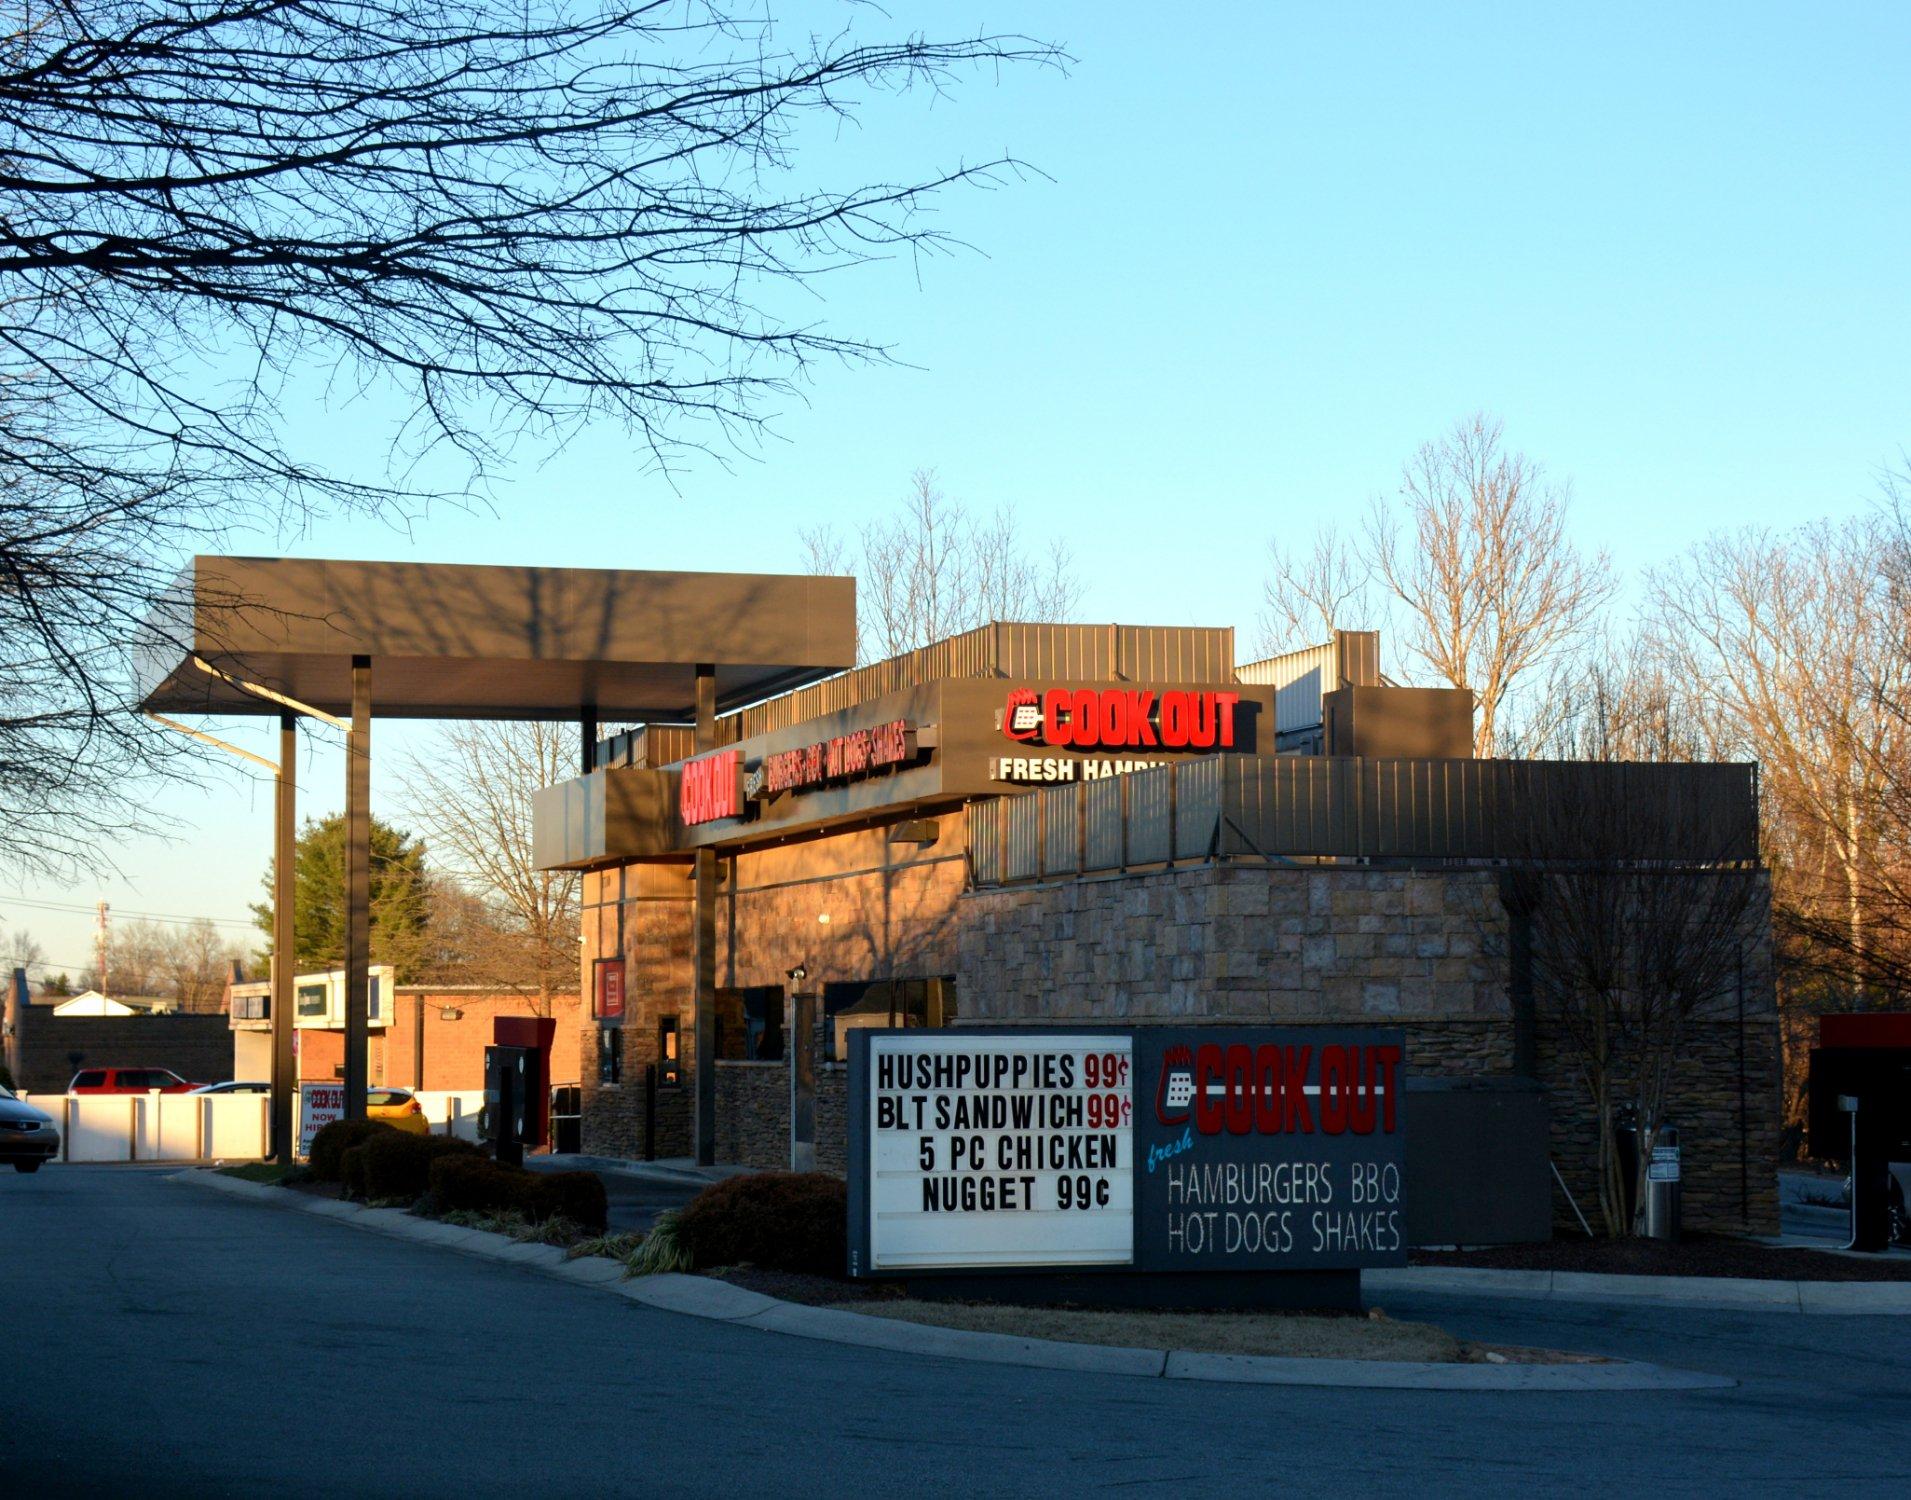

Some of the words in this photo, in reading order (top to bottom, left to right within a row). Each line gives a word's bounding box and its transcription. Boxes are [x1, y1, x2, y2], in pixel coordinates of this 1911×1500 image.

[1042, 688, 1157, 746] COOK
[1159, 690, 1239, 747] OUT
[871, 718, 905, 767] SHAKES
[681, 757, 714, 826] COOK
[713, 750, 738, 819] OUT
[1000, 758, 1074, 781] FRESH
[1083, 759, 1165, 781] HAM
[878, 1053, 1075, 1089] HUSHPUPPIES
[1084, 1053, 1129, 1089] 99¢
[1196, 1043, 1315, 1135] COOK
[1320, 1044, 1400, 1135] OUT
[312, 1113, 336, 1121] NOW
[877, 1095, 928, 1130] BLT
[935, 1094, 1083, 1130] SANDWICH
[920, 1136, 935, 1171] 5
[951, 1135, 985, 1171] PC
[997, 1134, 1117, 1171] CHICKEN
[1147, 1127, 1194, 1174] fresh
[923, 1176, 1036, 1212] NUGGET
[1057, 1175, 1110, 1210] 99¢
[1168, 1162, 1333, 1204] HAMBURGERS
[1351, 1162, 1400, 1204] BBQ
[1168, 1211, 1219, 1253] HOT
[1225, 1211, 1293, 1253] DOGS
[1312, 1210, 1400, 1252] SHAKES
